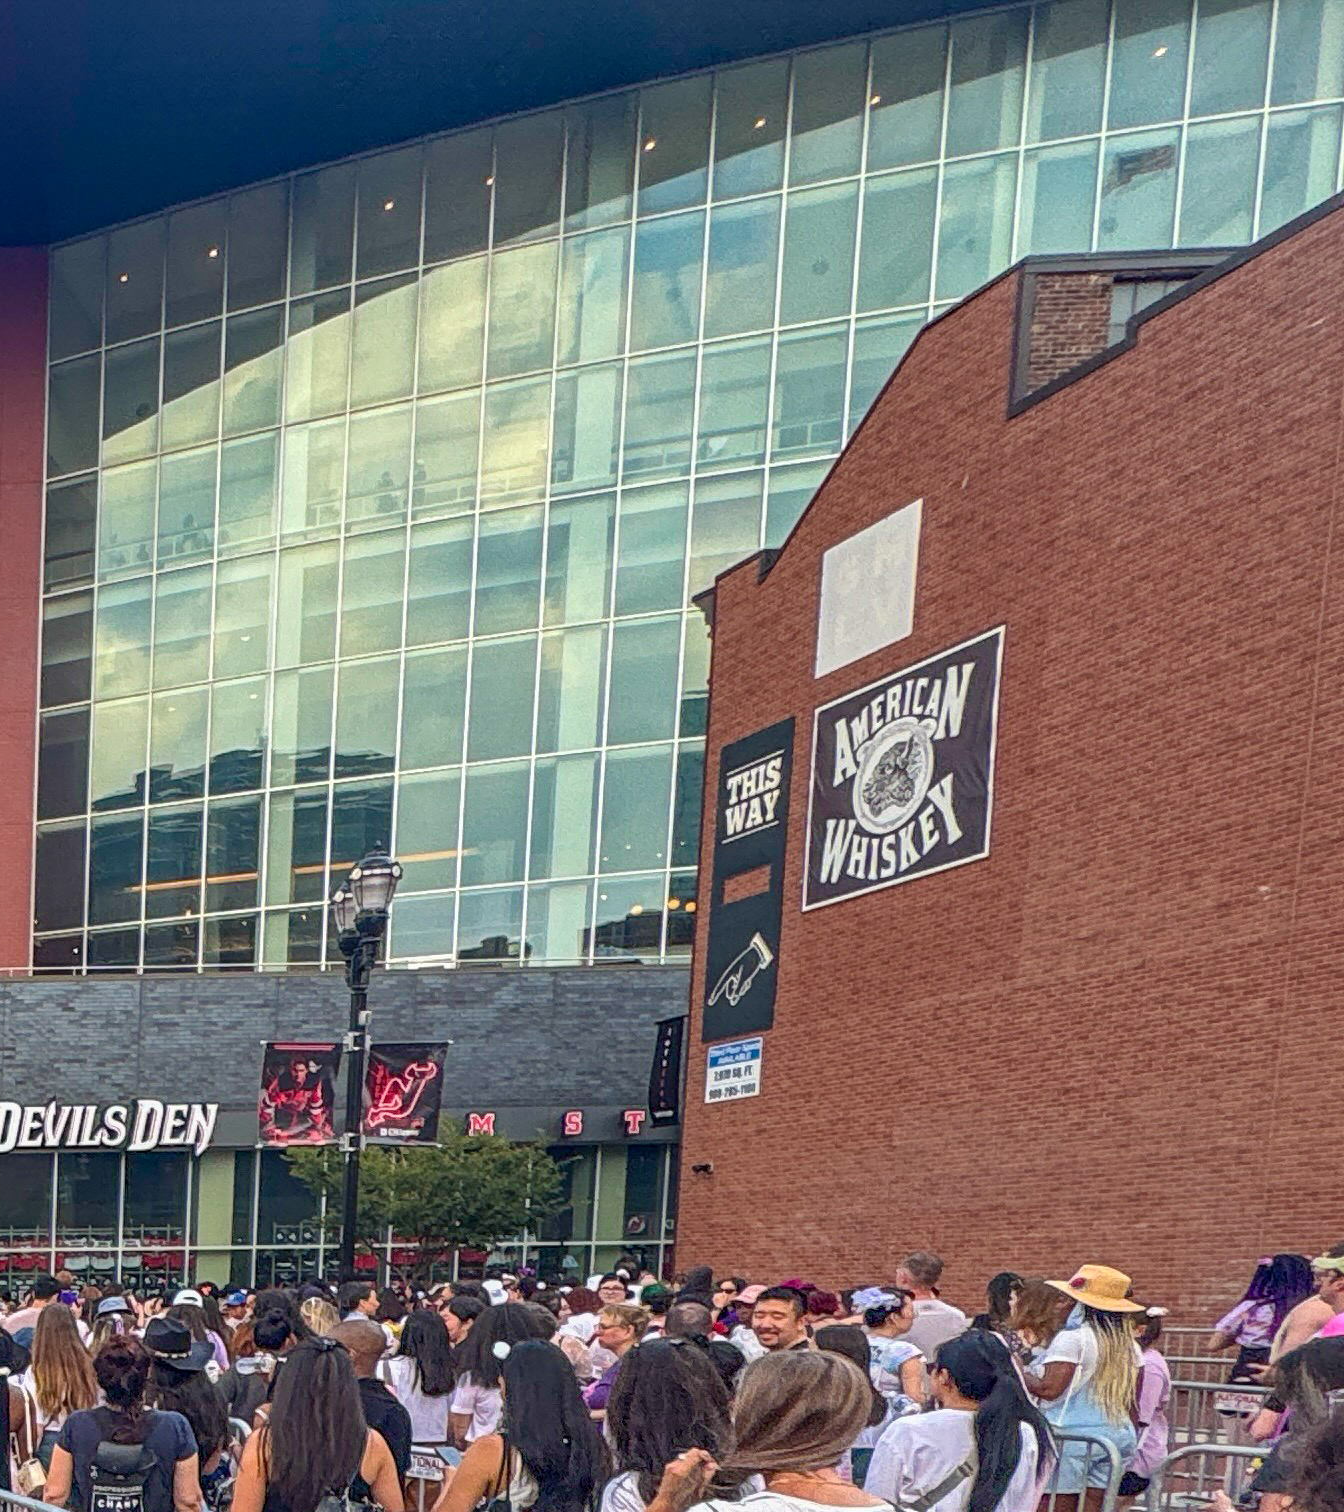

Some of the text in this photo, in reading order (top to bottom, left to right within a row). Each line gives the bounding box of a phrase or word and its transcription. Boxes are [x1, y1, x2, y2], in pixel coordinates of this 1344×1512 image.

[833, 662, 976, 787] AMERICAN
[727, 757, 783, 805] THIS
[725, 789, 781, 836] WAY
[820, 773, 963, 884] WHISKEY
[127, 1099, 219, 1157] DEN
